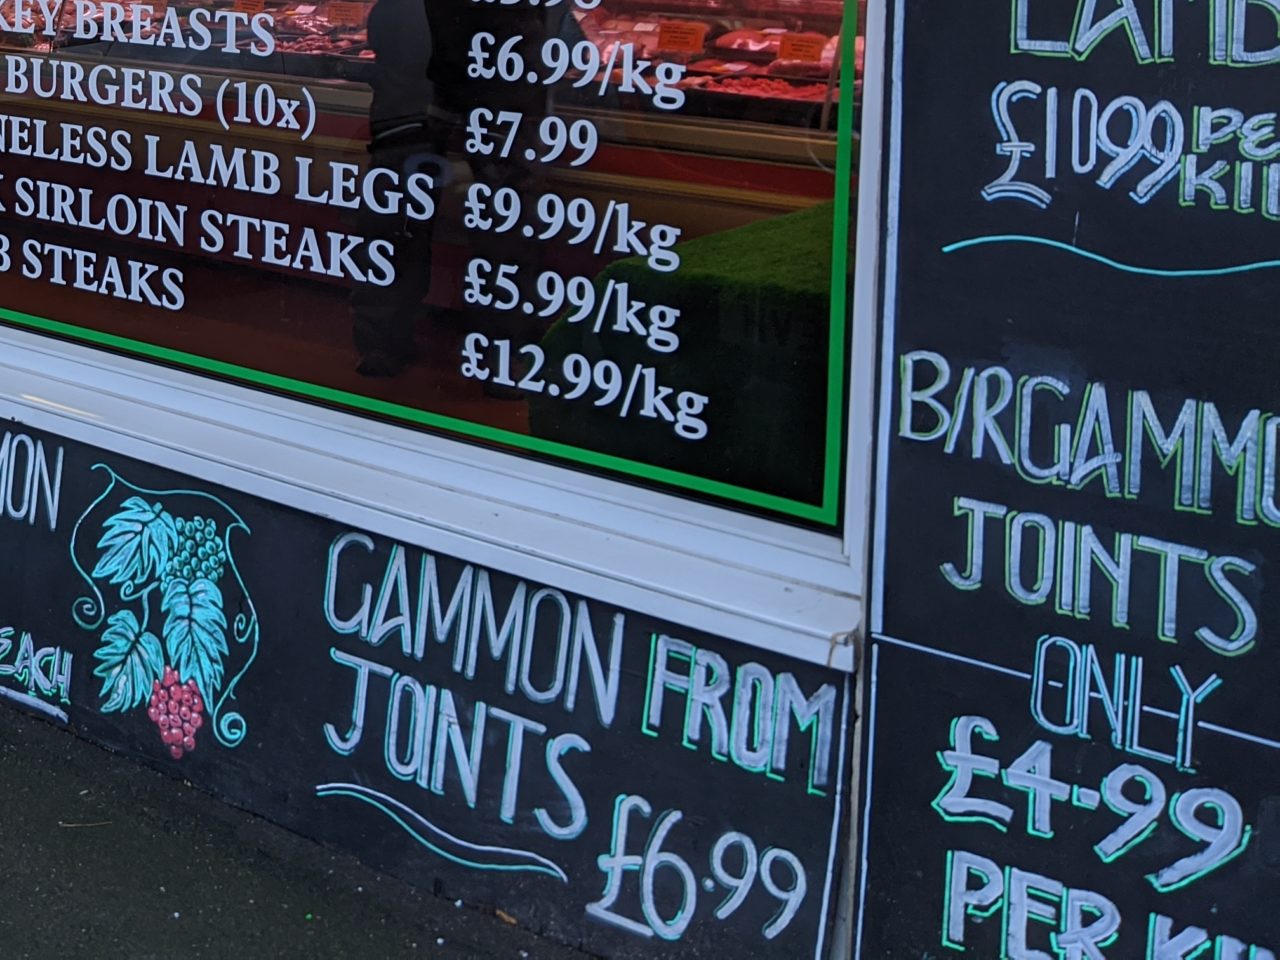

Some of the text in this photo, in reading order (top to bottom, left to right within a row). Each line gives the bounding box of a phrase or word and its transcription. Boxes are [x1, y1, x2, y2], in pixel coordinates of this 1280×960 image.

[5, 55, 203, 117] BURGERS
[217, 78, 317, 141] (10x)
[466, 107, 598, 166] £7.99
[468, 32, 687, 110] £6.99/kg
[15, 177, 186, 246] SIRLOIN
[200, 209, 396, 288] STEAKS
[464, 258, 681, 353] £5.99/kg
[145, 135, 280, 195] LAMB
[295, 157, 435, 221] LEGS
[464, 183, 682, 272] £9.99/kg
[22, 239, 185, 311] STEAKS
[461, 332, 709, 440] £12.99/kg
[940, 496, 1257, 656] JOINTS
[324, 532, 836, 797] GAMMON FROM
[1030, 635, 1222, 773] ONLY
[324, 647, 592, 840] JOINTS
[942, 850, 1121, 960] PER
